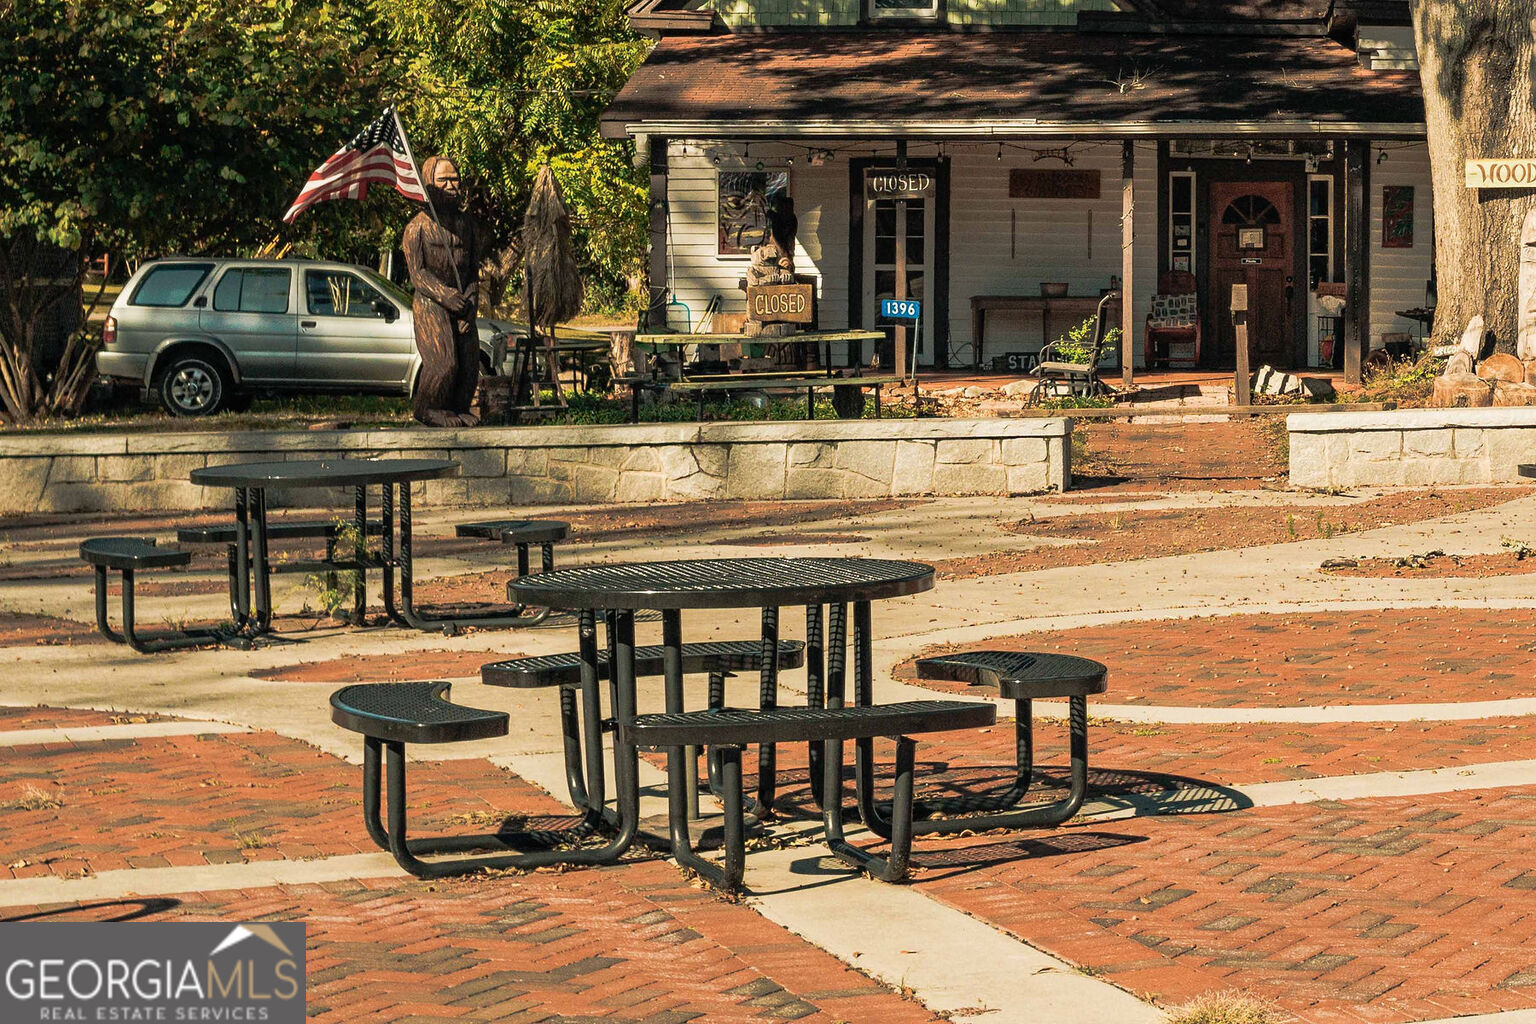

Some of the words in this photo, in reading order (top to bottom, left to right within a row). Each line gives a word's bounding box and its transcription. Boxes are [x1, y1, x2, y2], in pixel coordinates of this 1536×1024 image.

[873, 173, 930, 193] CLOSED
[755, 293, 805, 315] CLOSED
[886, 301, 915, 316] 1396
